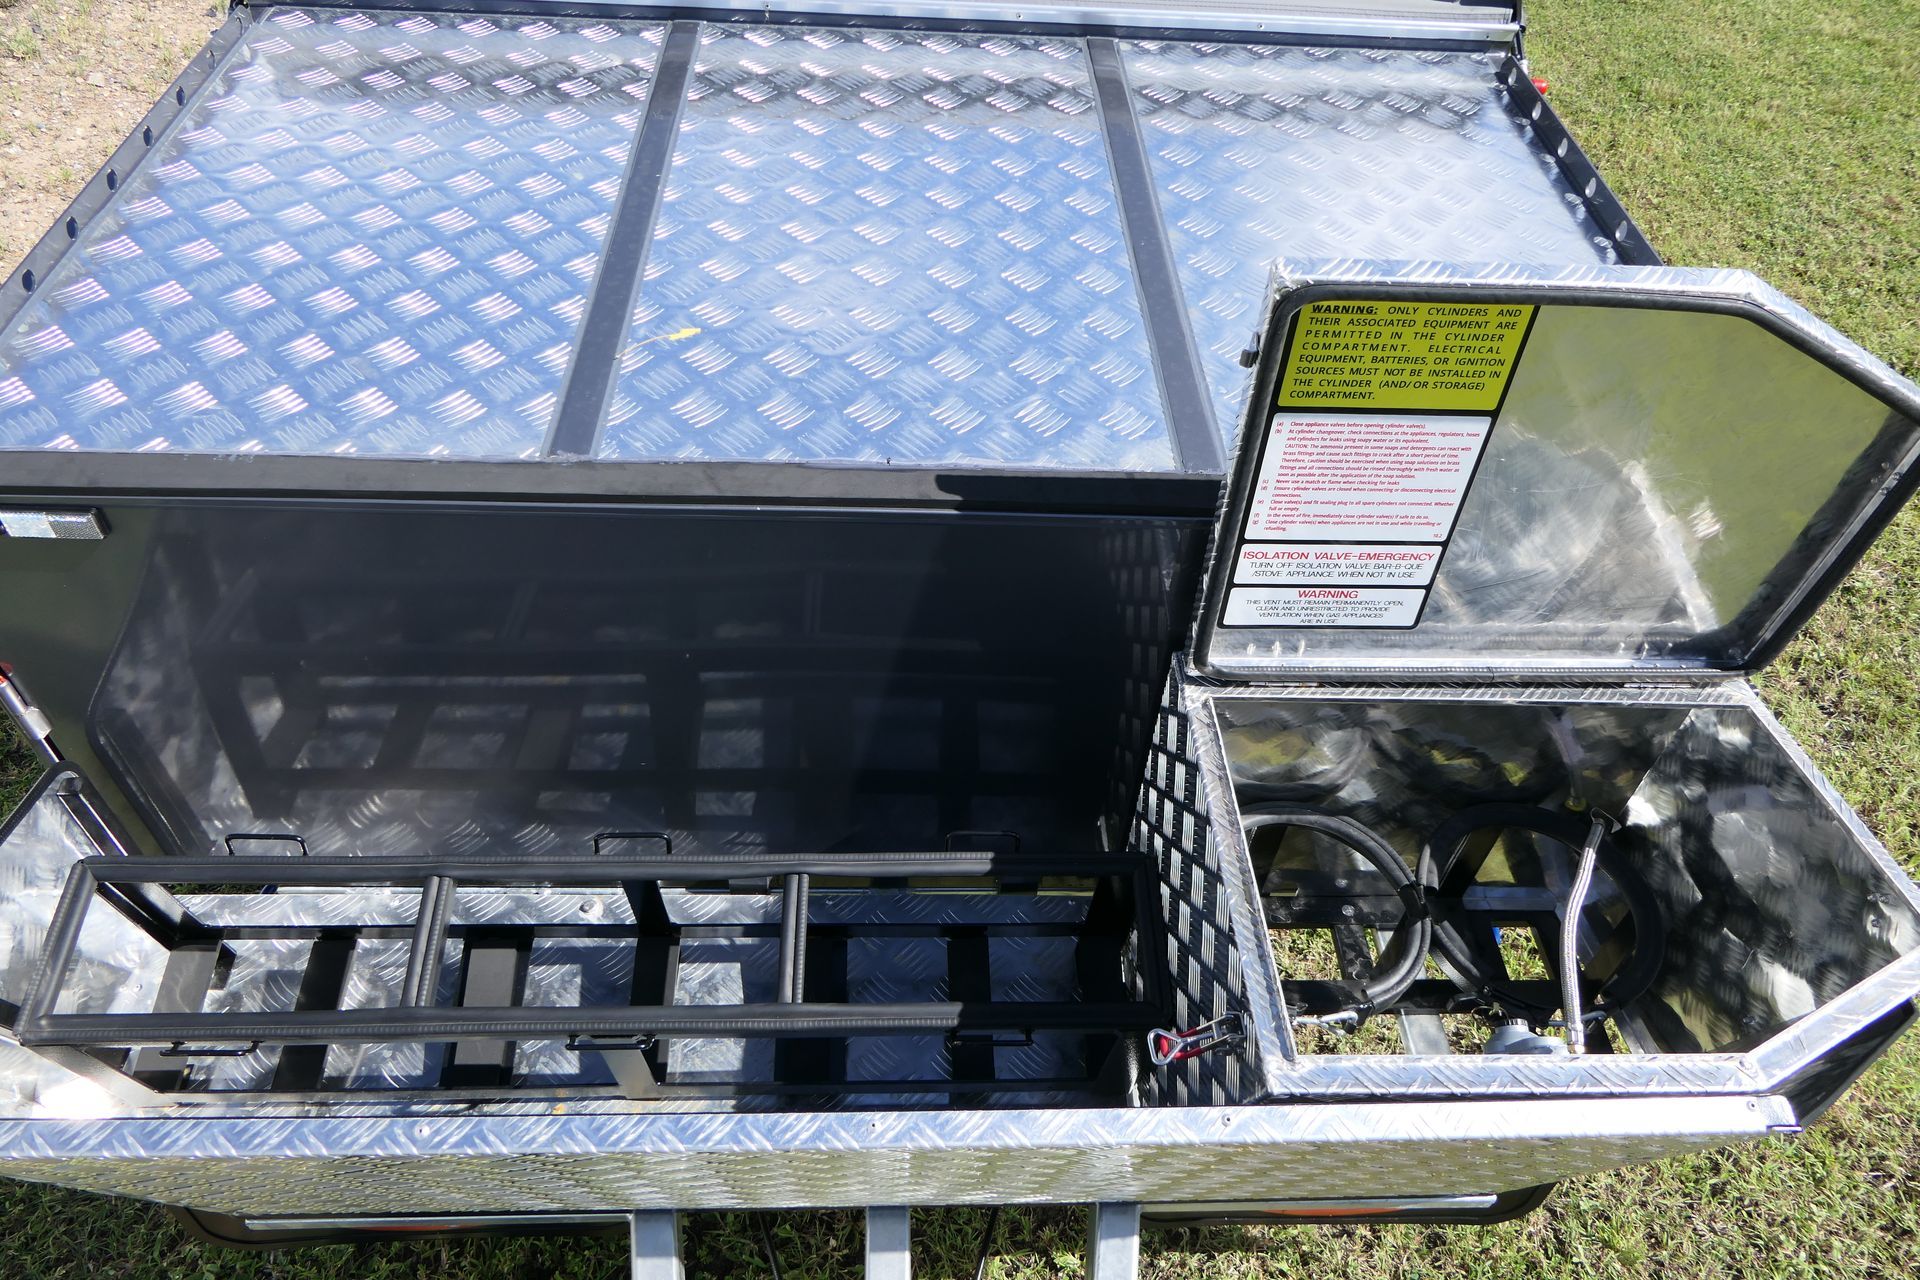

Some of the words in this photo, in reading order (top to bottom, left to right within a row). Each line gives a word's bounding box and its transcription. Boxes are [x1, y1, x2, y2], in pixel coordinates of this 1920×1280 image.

[1311, 305, 1379, 314] WARNING:
[1388, 306, 1418, 314] ONLY
[1428, 307, 1488, 316] CYLINDERS
[1497, 308, 1522, 316] AND
[1308, 317, 1341, 325] THEIR
[1348, 318, 1416, 327] ASSOCIATED
[1423, 320, 1489, 329] EQUIPMENT
[1305, 330, 1382, 338] PERMITTED
[1445, 332, 1505, 341] CYLINDER
[1302, 342, 1412, 352] COMPARTMENT.
[1428, 344, 1502, 354] ELECTRICAL
[1298, 354, 1366, 364] EQUIPMENT,
[1371, 356, 1429, 365] BATTERIES,
[1455, 357, 1505, 366] IGNITION
[1296, 366, 1345, 374] SOURCES
[1349, 367, 1378, 375] MUST
[1428, 369, 1486, 378] INSTALLED
[1319, 379, 1372, 387] CYLINDER
[1379, 380, 1411, 390] (AND/
[1432, 381, 1485, 391] STORAGE)
[1290, 390, 1376, 399] COMPARTMENT.
[1243, 551, 1309, 559] ISOLATION
[1313, 552, 1435, 561] VALVE-EMERGENCY
[1297, 590, 1359, 598] WARNING
